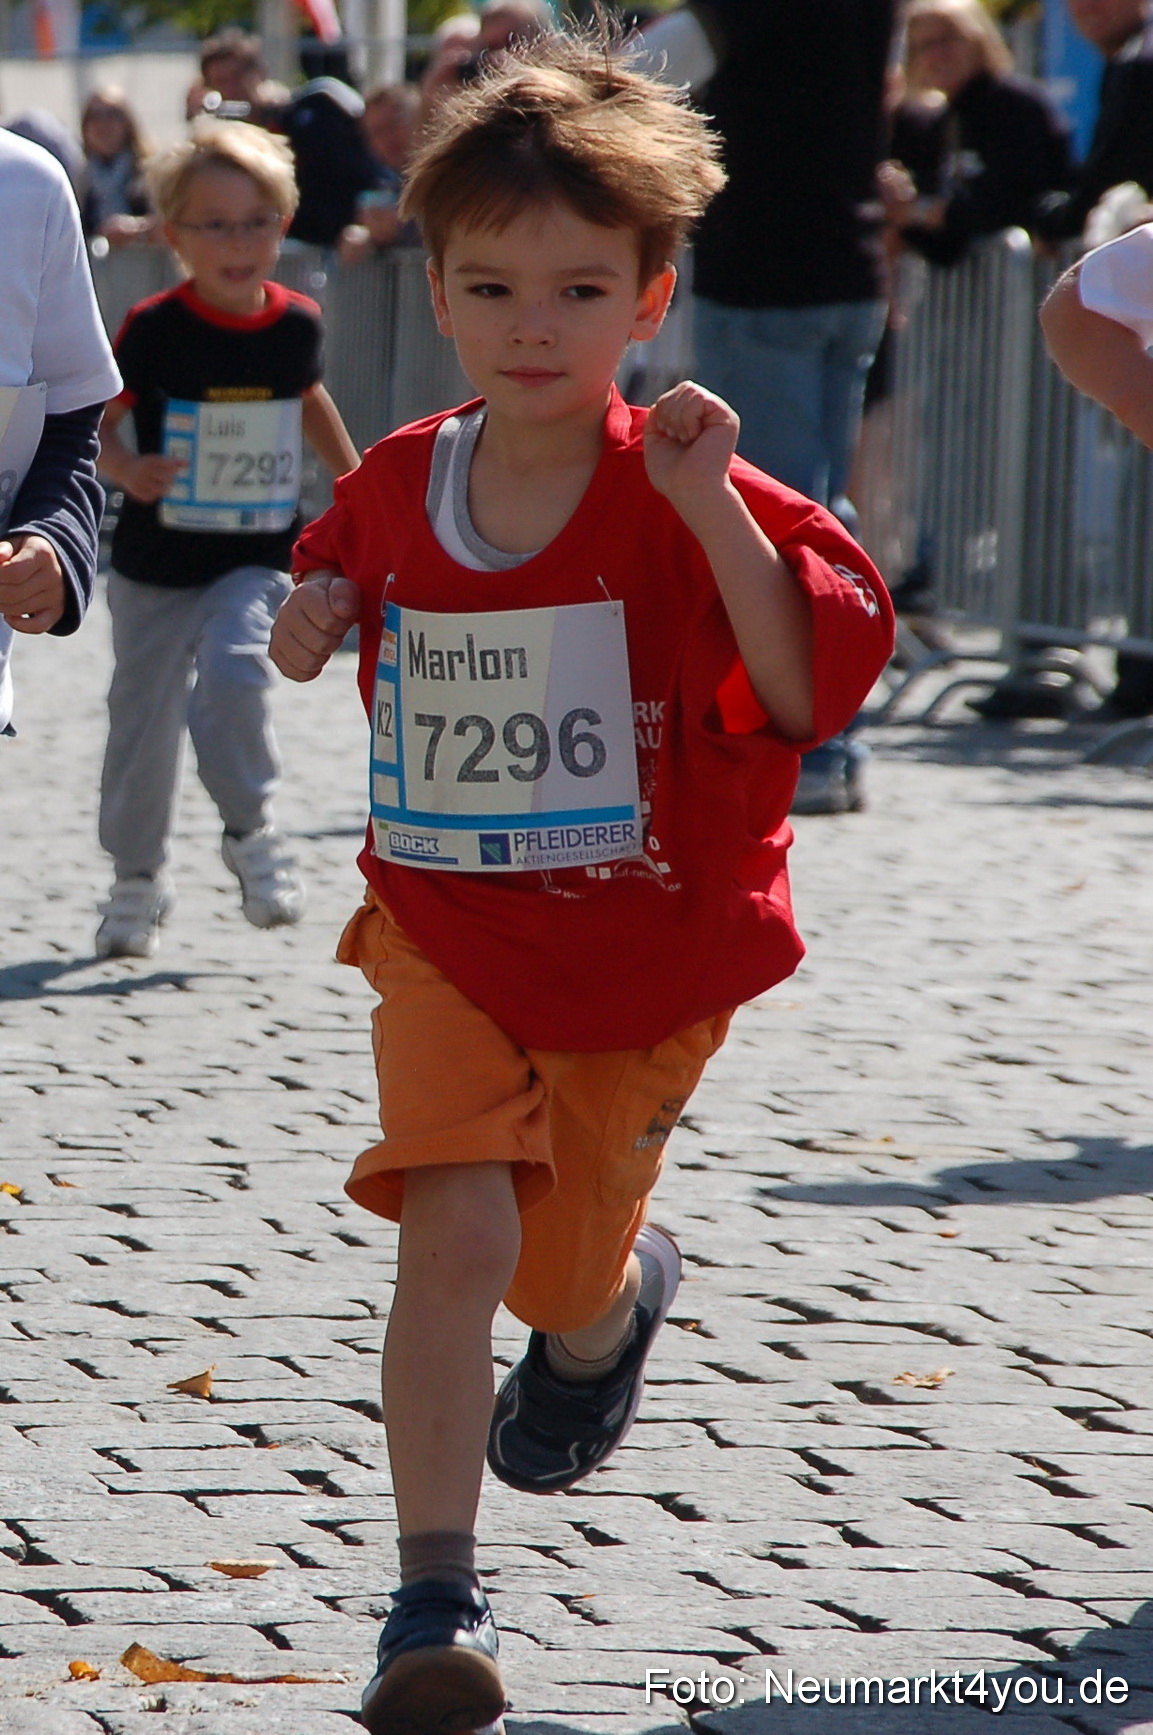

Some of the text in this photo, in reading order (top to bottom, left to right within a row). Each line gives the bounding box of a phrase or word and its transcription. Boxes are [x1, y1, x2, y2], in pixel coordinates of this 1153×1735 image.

[207, 413, 247, 438] Luis
[207, 449, 294, 487] 7292
[407, 629, 528, 681] Marlon
[377, 700, 393, 738] K2
[414, 706, 607, 783] 7296
[389, 831, 439, 855] BOCK
[514, 823, 637, 852] PFLEIDERER
